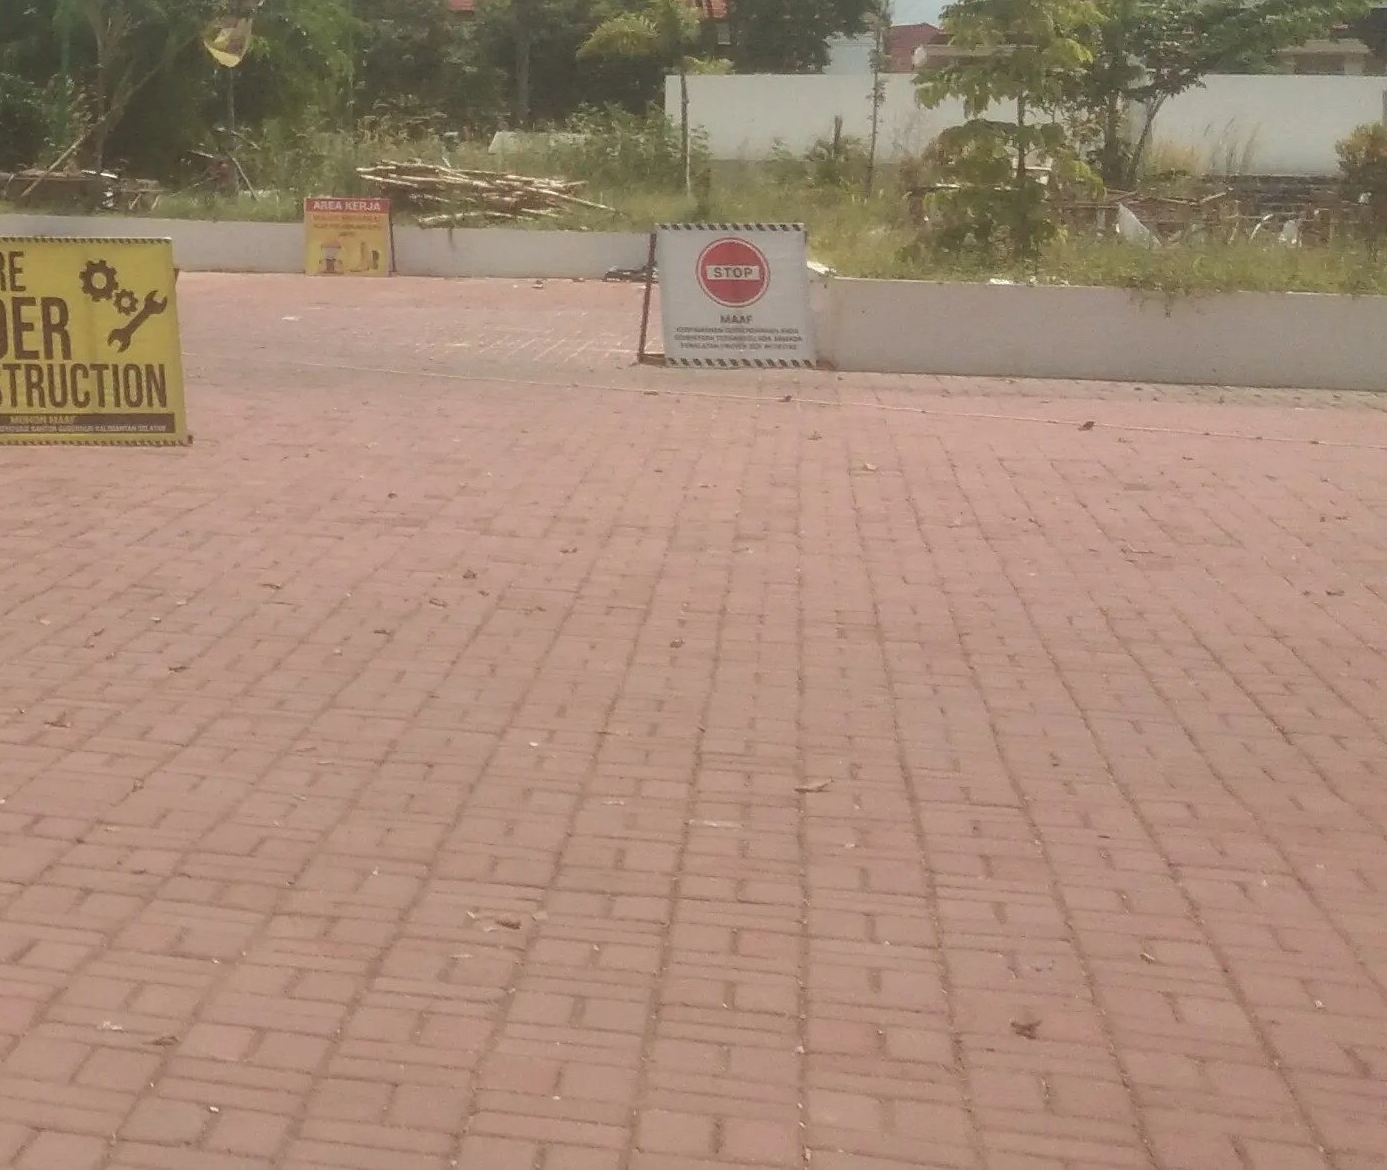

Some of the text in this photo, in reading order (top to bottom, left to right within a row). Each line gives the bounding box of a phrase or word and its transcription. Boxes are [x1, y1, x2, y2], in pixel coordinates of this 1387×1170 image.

[313, 201, 380, 211] AREA KERJA
[713, 267, 753, 278] STOP
[720, 315, 753, 324] MAAF
